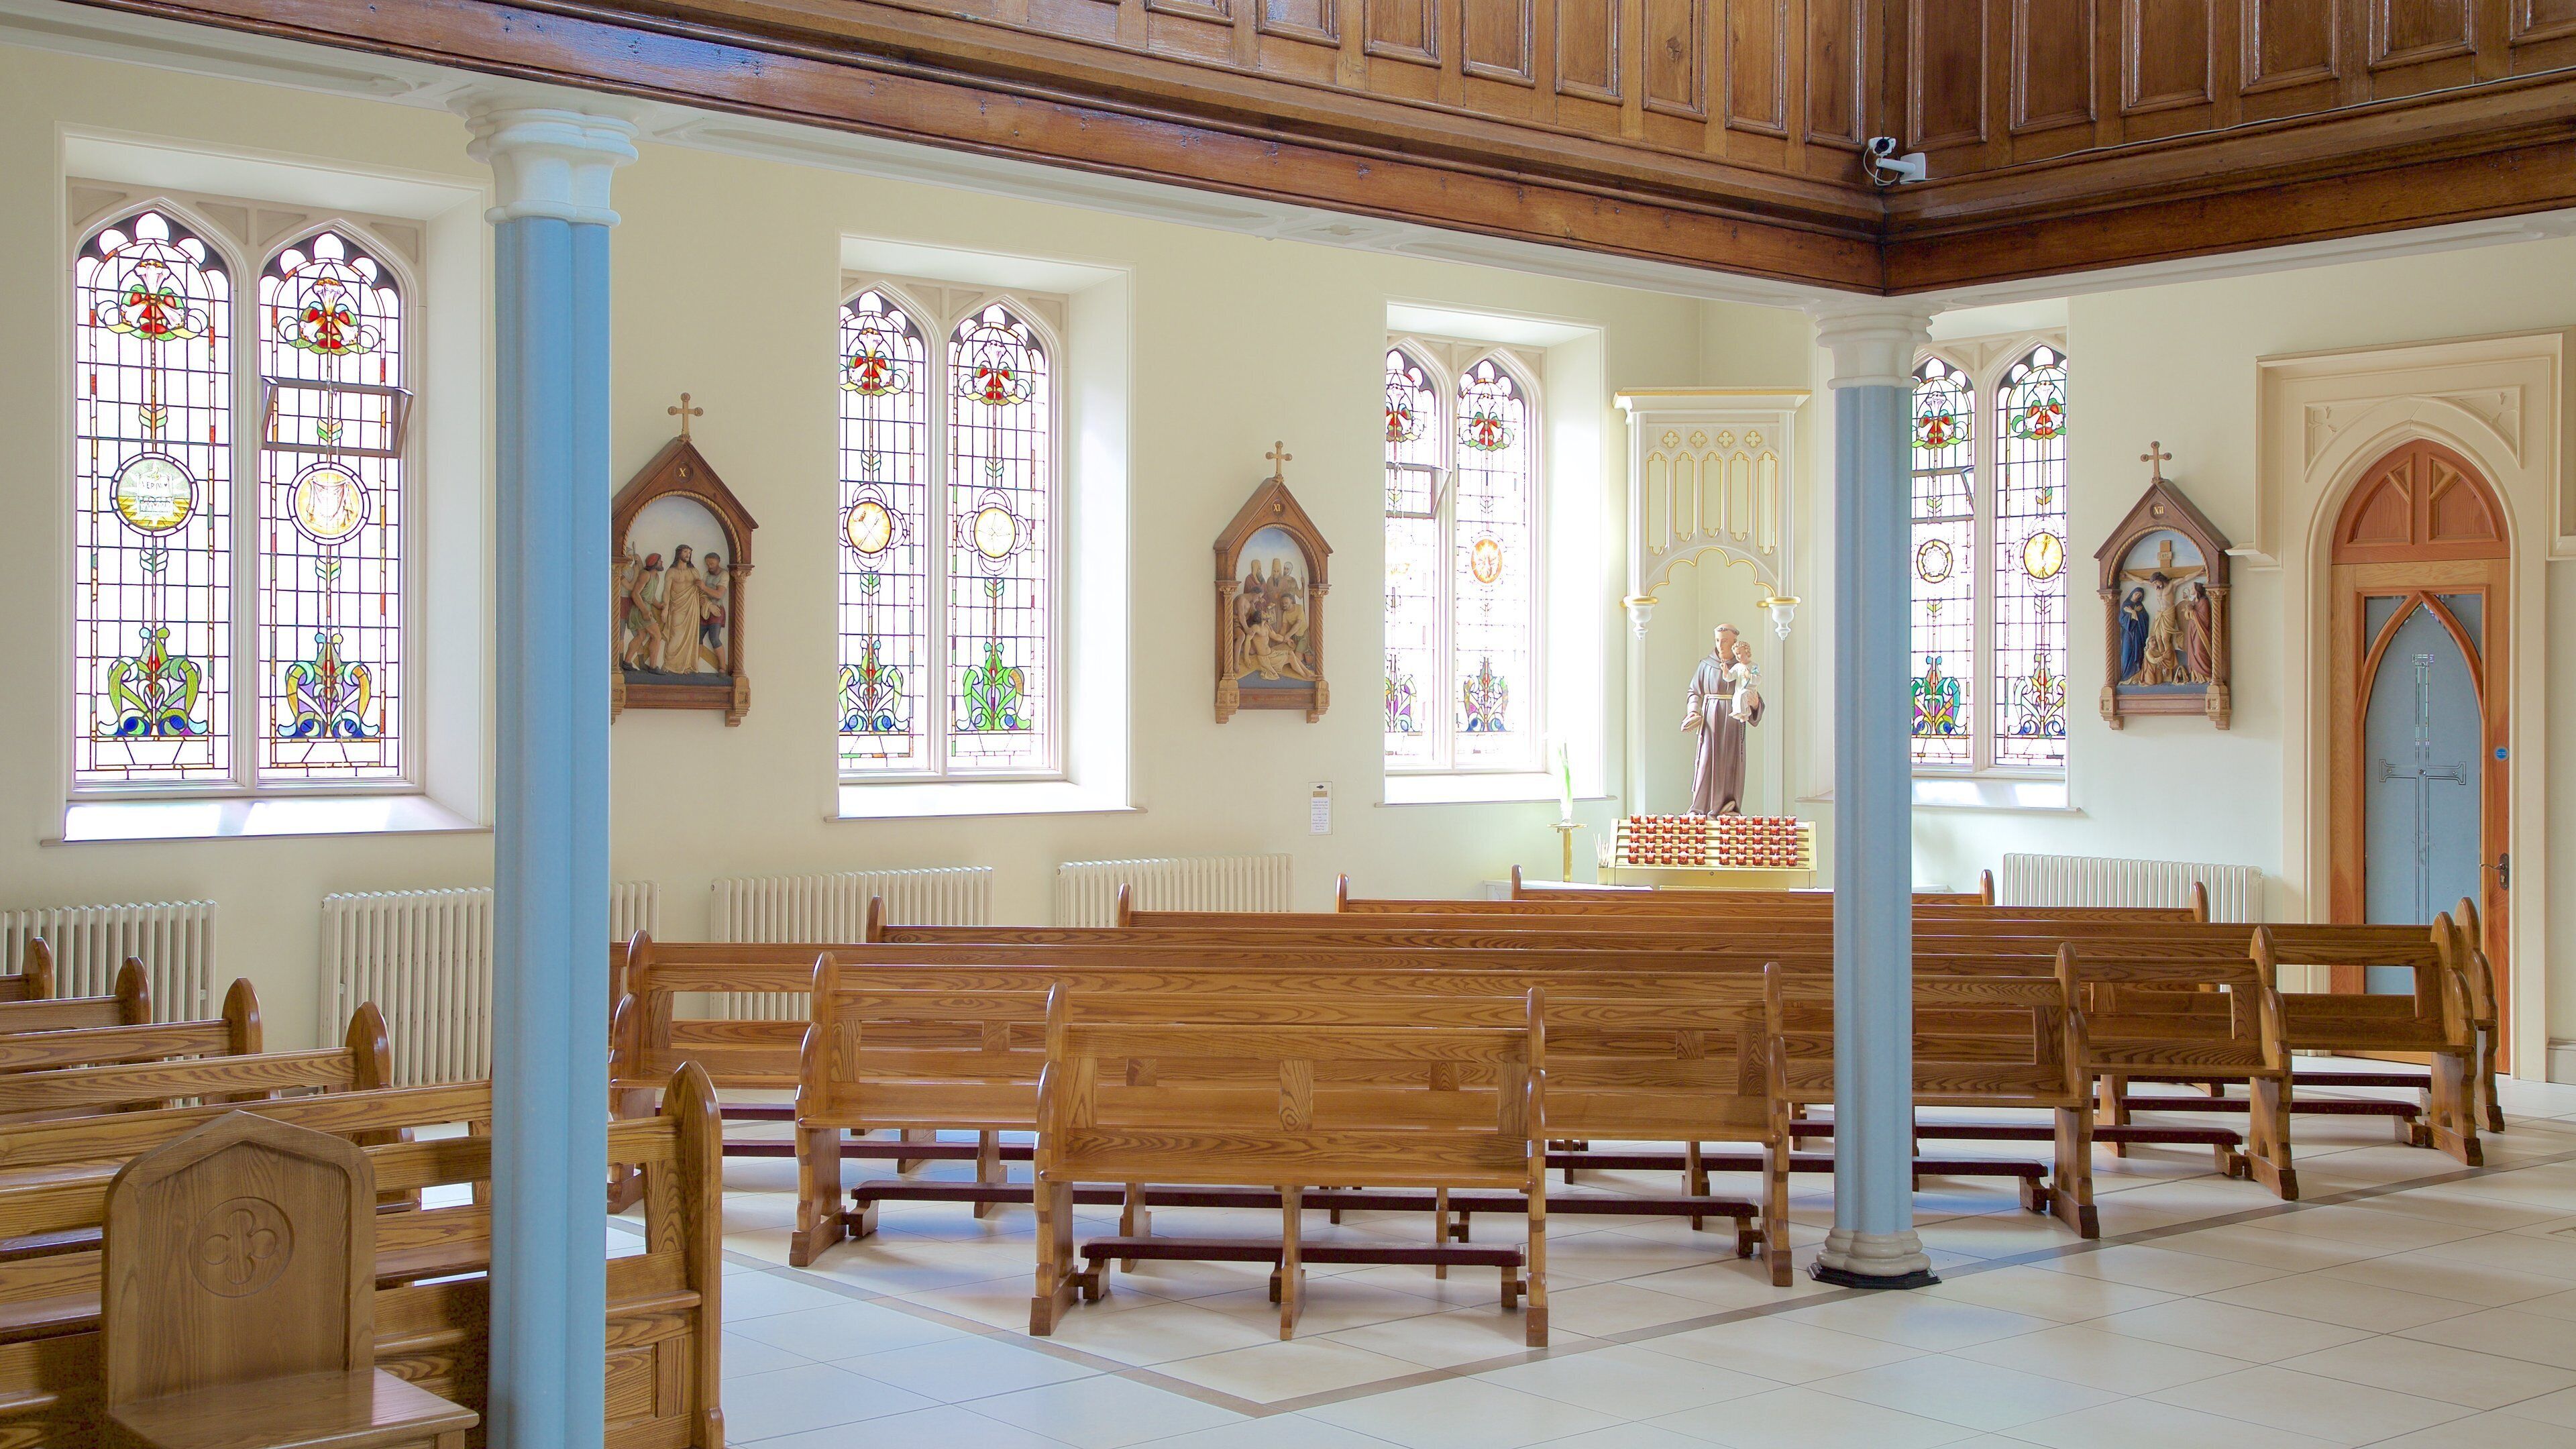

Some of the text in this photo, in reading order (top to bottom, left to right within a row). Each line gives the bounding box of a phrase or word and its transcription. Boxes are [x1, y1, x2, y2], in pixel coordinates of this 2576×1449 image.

[678, 468, 686, 477] X
[1273, 504, 1281, 512] XI
[2153, 506, 2164, 515] XII
